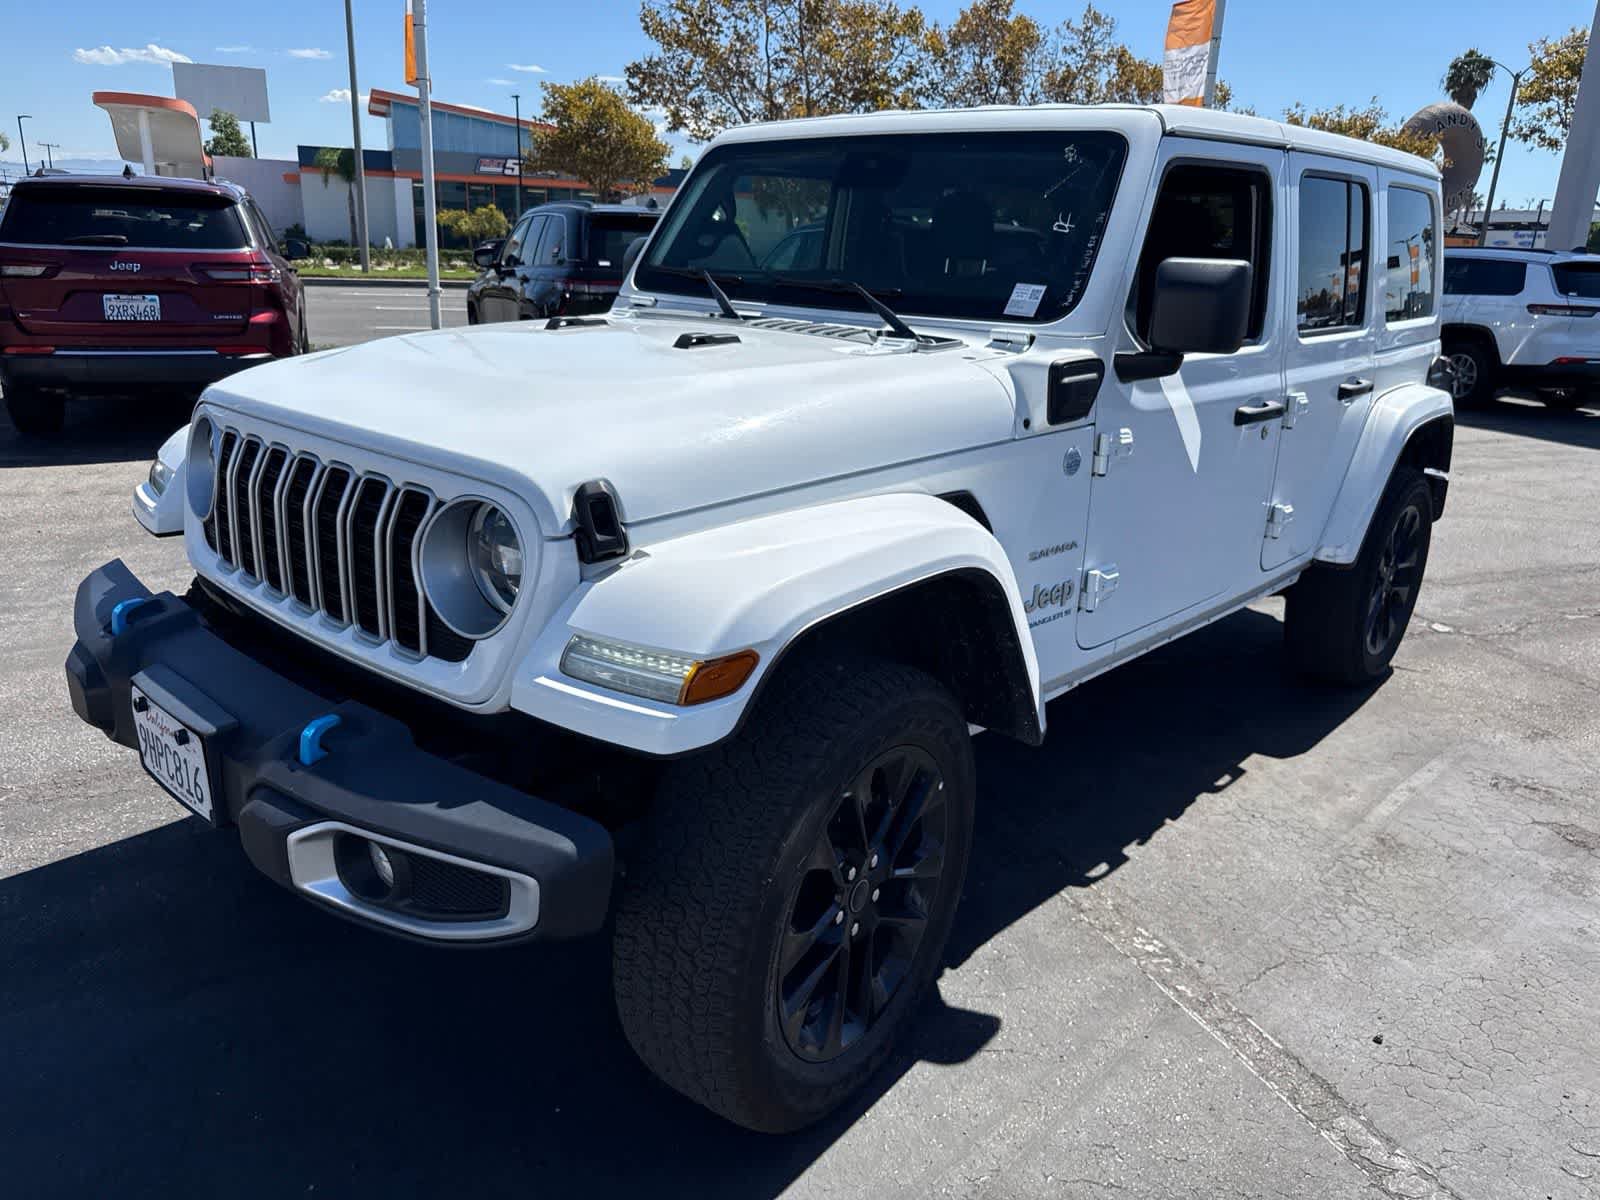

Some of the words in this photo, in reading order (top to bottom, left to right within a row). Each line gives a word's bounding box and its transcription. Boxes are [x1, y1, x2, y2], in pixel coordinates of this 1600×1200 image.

[110, 261, 141, 272] Jeep
[109, 304, 156, 319] 9XRS468
[1028, 540, 1078, 561] SAHARA
[1023, 579, 1074, 613] Jeep
[138, 722, 204, 804] 9HPC816
